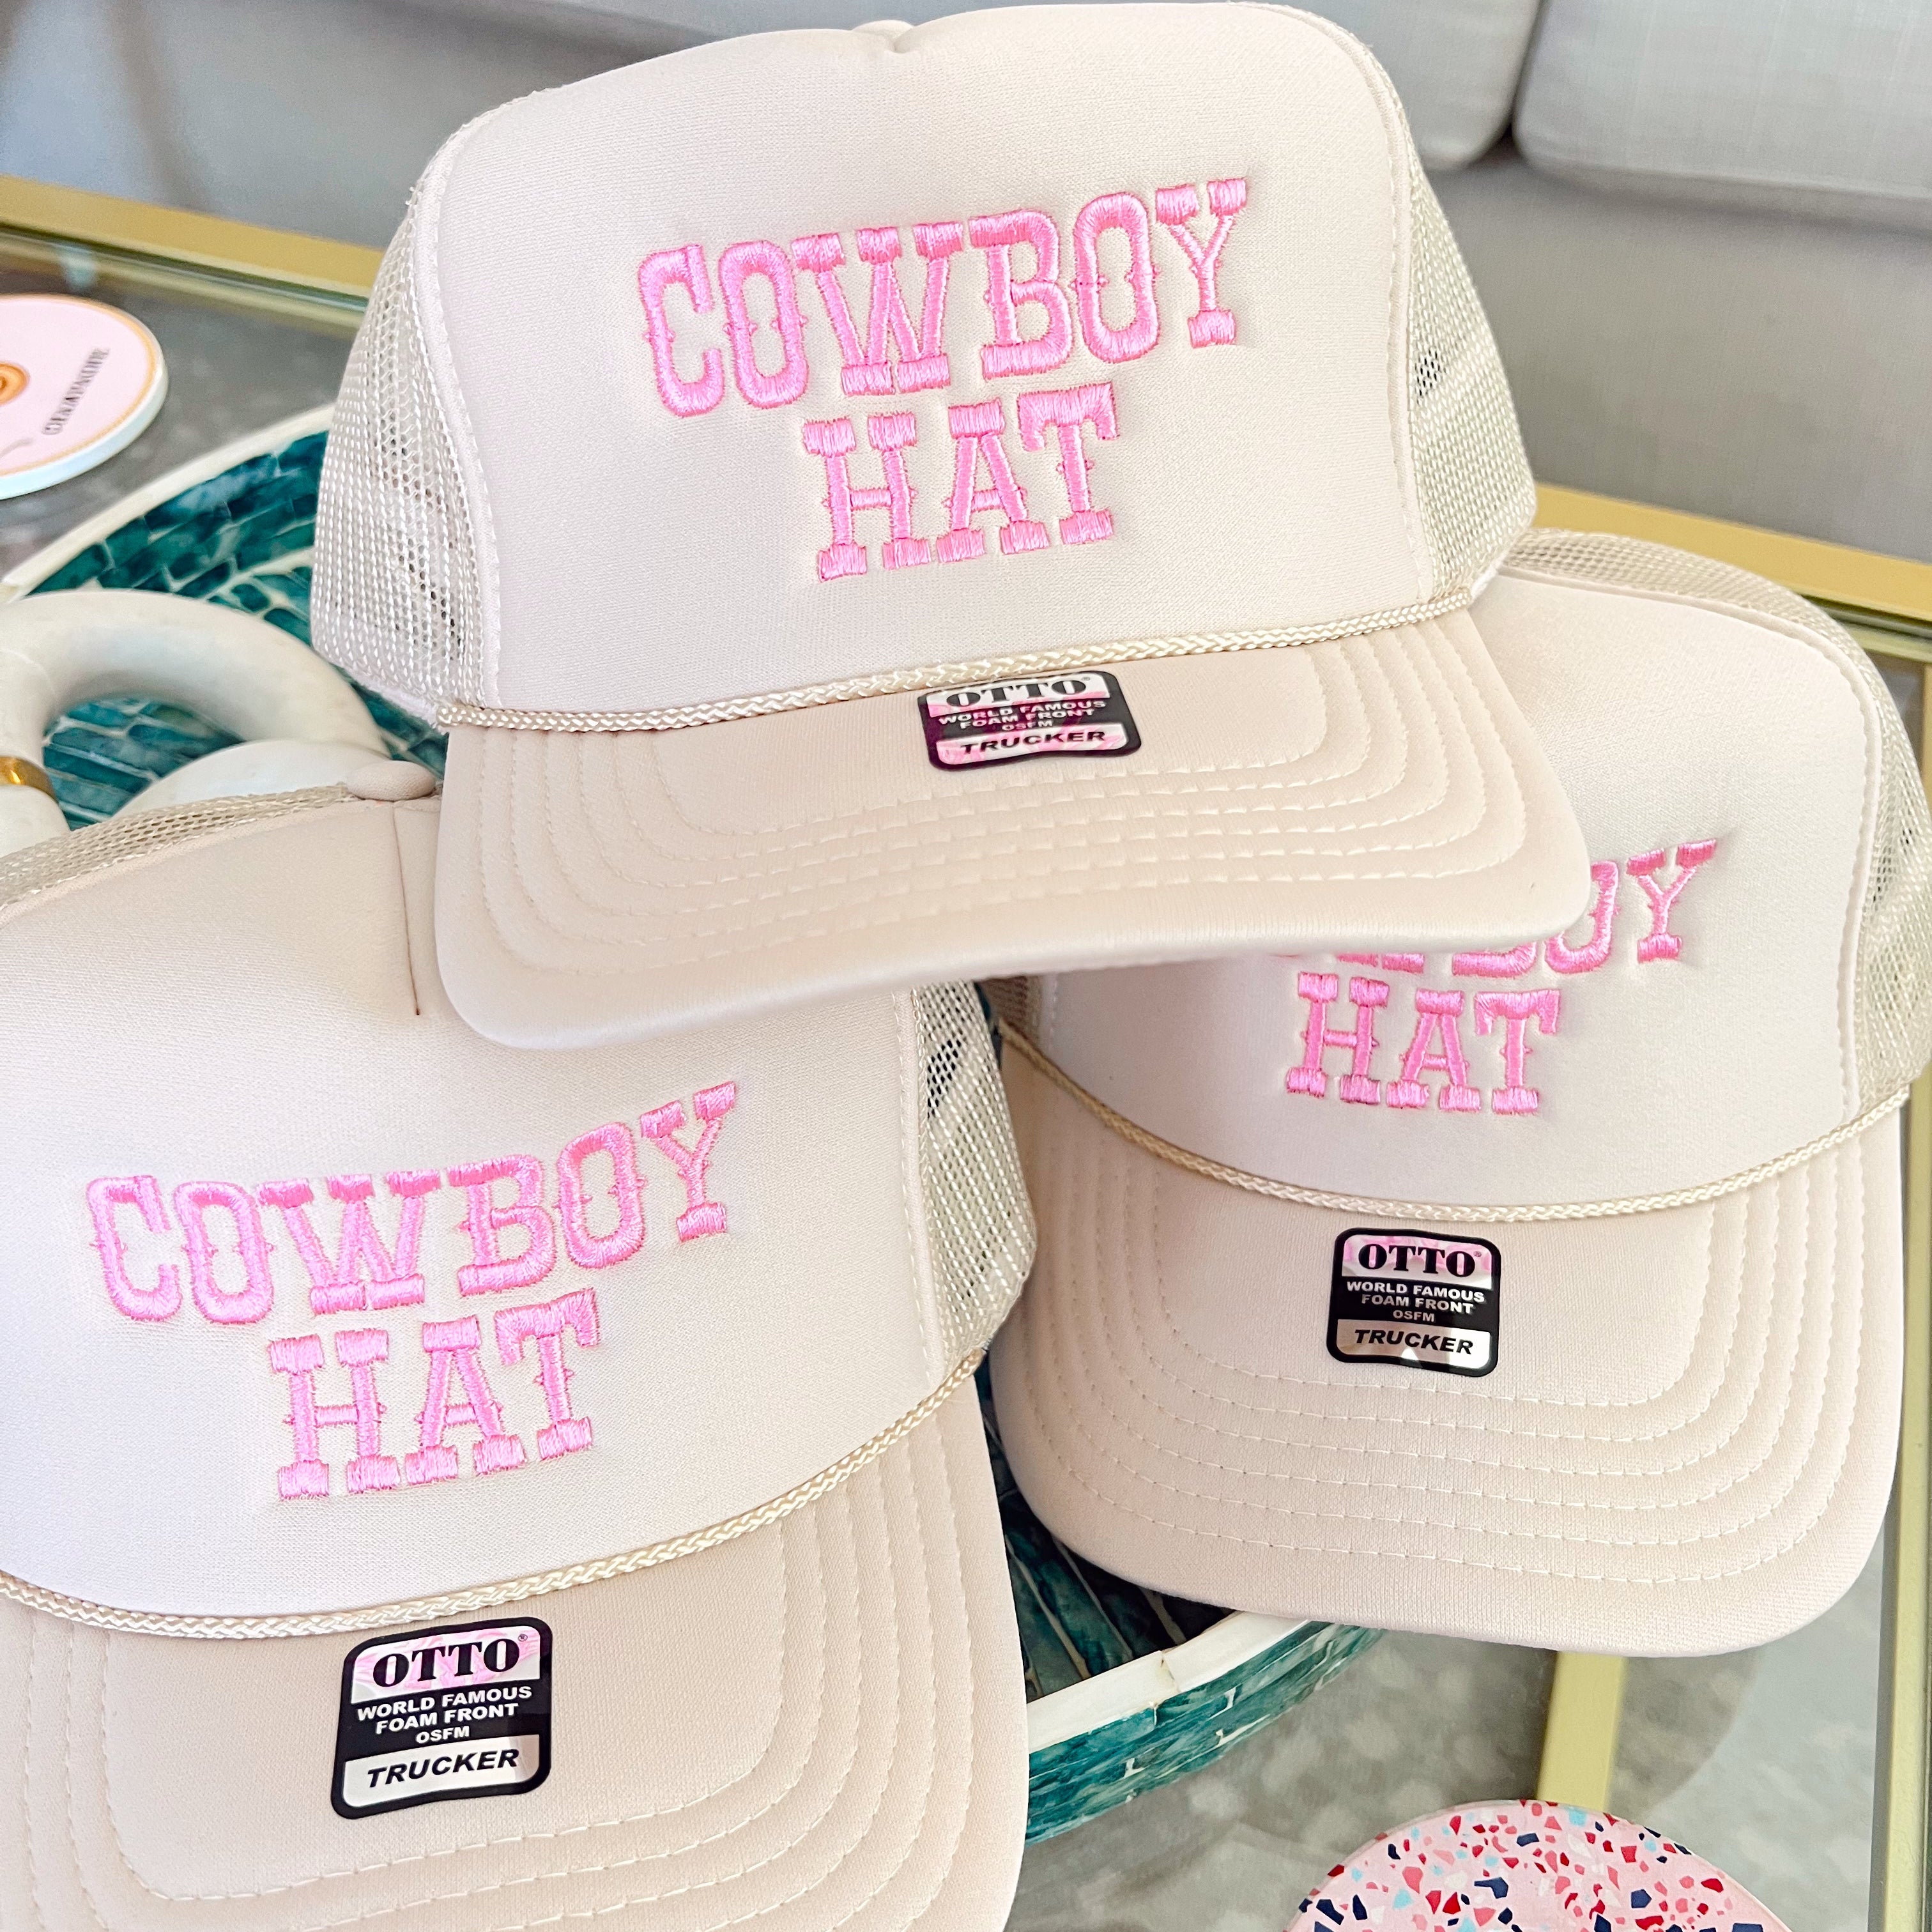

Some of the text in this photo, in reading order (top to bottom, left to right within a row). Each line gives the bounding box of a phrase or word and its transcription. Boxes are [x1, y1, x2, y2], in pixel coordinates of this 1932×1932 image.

[638, 178, 1248, 417] COWBOY
[802, 382, 1120, 582] HAT
[946, 679, 1086, 707] OTTO
[939, 700, 1107, 725] WORLD FAMOUS
[960, 709, 1095, 730] FOAM FRONT
[1001, 720, 1053, 731] OSFM
[960, 731, 1105, 755] TRUCKER
[1286, 972, 1561, 1115] HAT
[87, 1081, 737, 1324] COWBOY
[1358, 1243, 1475, 1277] OTTO
[1347, 1281, 1485, 1303] WORLD FAMOUS
[1361, 1294, 1474, 1314] FOAM FRONT
[1393, 1310, 1435, 1322] OSFM
[1354, 1329, 1473, 1354] TRUCKER
[268, 1287, 600, 1500] HAT
[372, 1638, 520, 1687] OTTO
[357, 1685, 532, 1721] WORLD FAMOUS
[376, 1703, 519, 1735] FOAM FRONT
[416, 1726, 470, 1744] OSFM
[367, 1749, 519, 1788] TRUCKER
